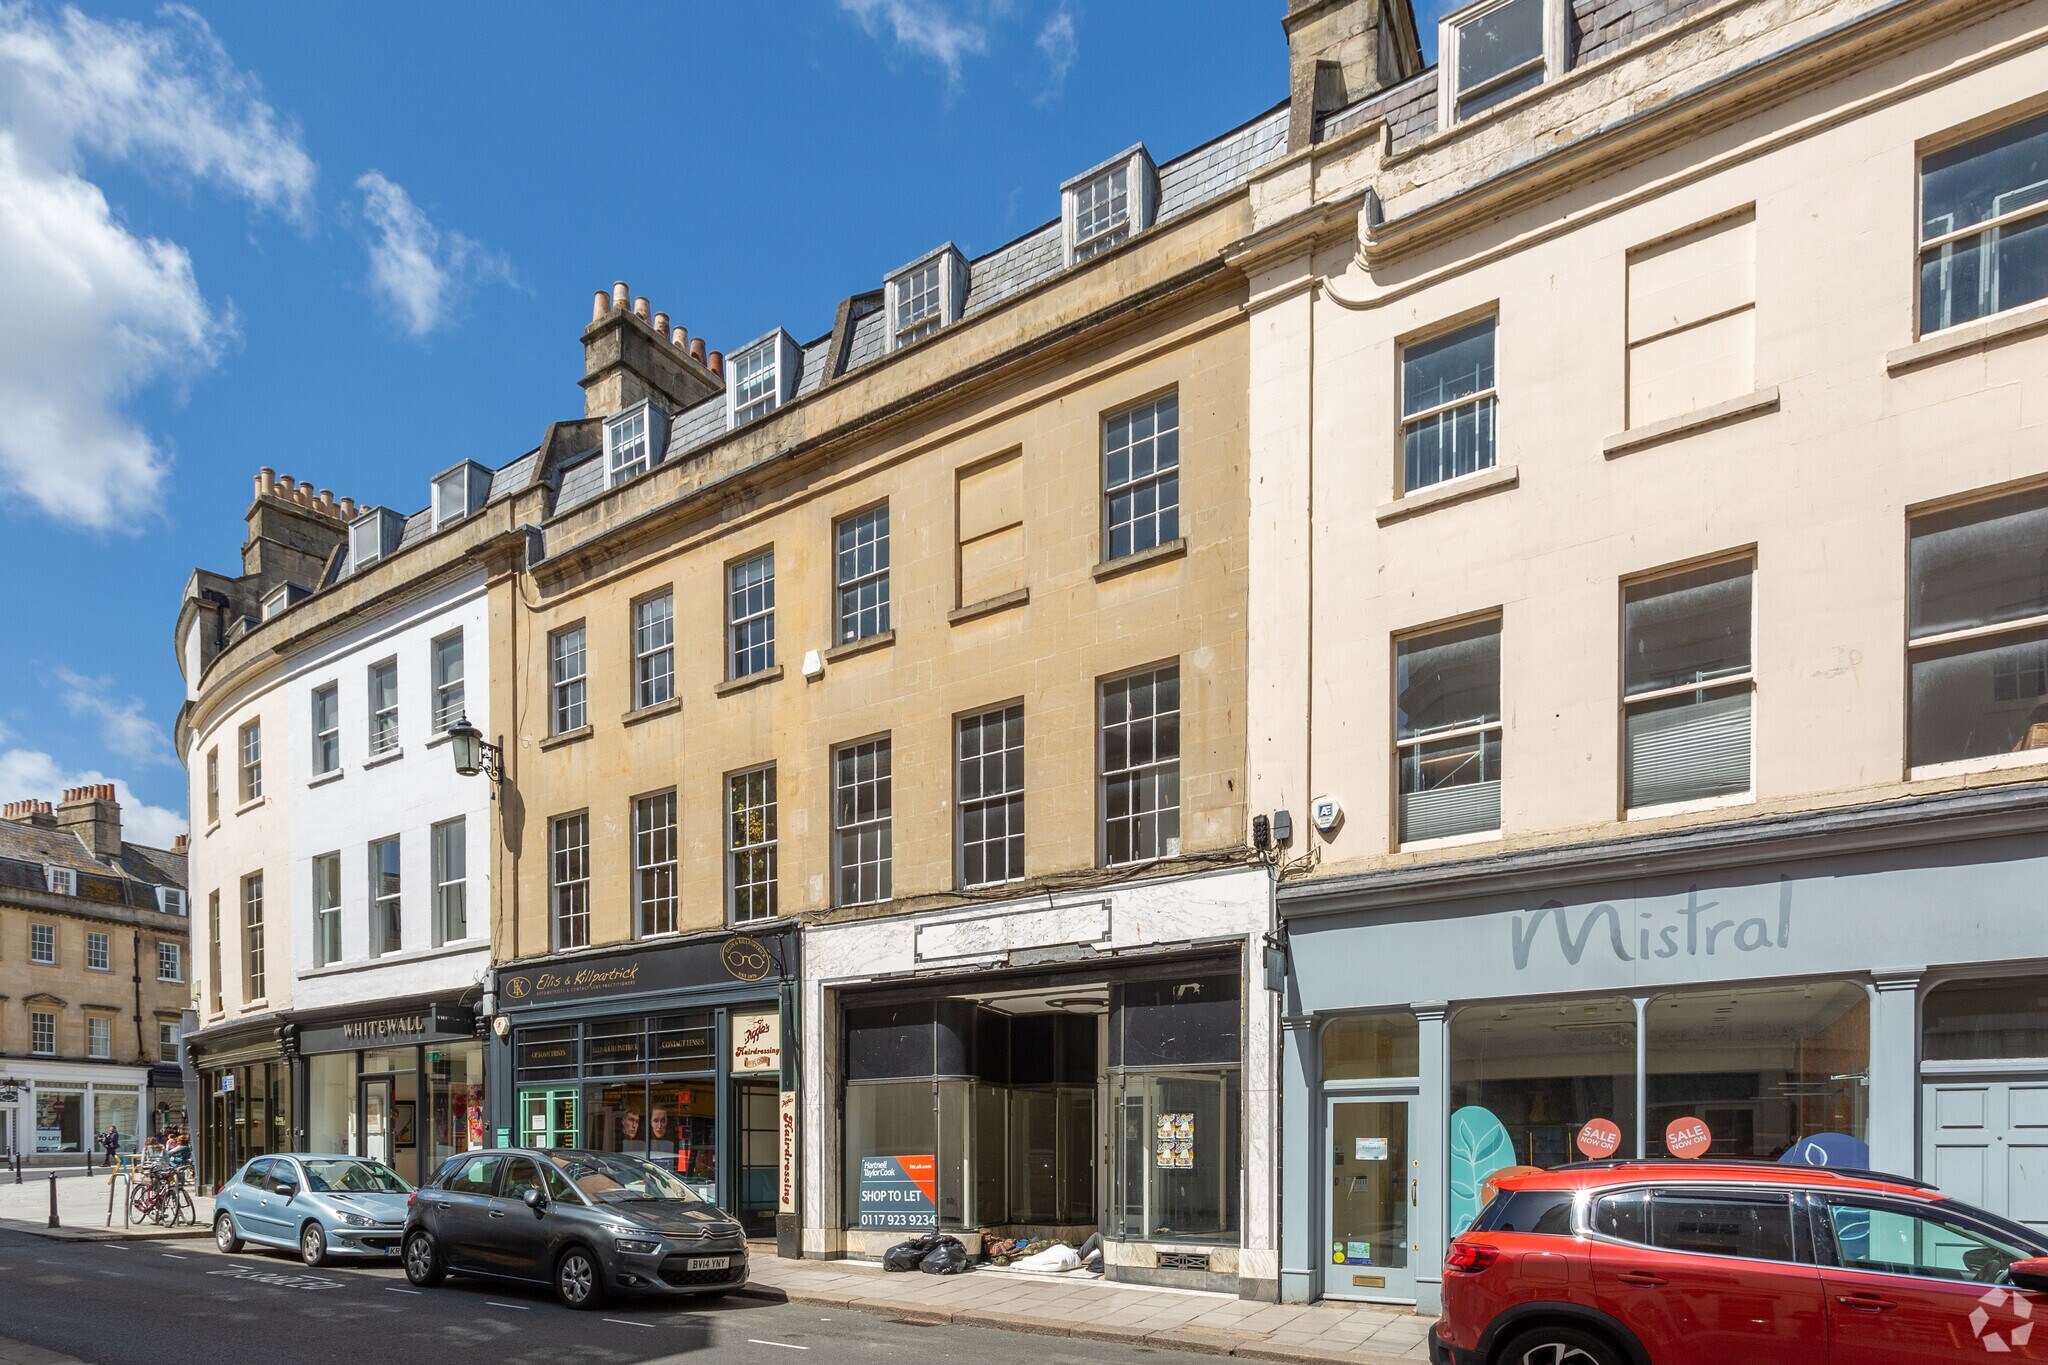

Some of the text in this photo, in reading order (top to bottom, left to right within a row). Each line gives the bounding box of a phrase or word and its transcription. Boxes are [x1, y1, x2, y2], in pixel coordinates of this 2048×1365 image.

[536, 974, 560, 990] Ellis
[564, 976, 570, 985] &
[343, 1015, 424, 1038] WHITEWALL
[686, 1038, 705, 1046] LENSES
[735, 1045, 780, 1057] Hairdressing
[1583, 1126, 1617, 1143] SALE
[1668, 1125, 1704, 1144] SALE
[1580, 1136, 1614, 1150] NOW ON
[1672, 1135, 1707, 1151] NOW ON
[782, 1113, 793, 1205] Hairdressing
[864, 1161, 887, 1169] Hartnell
[862, 1190, 921, 1202] SHOP TO LET
[861, 1214, 935, 1226] 0117 923 9234
[692, 1258, 726, 1269] BV14 YNY
